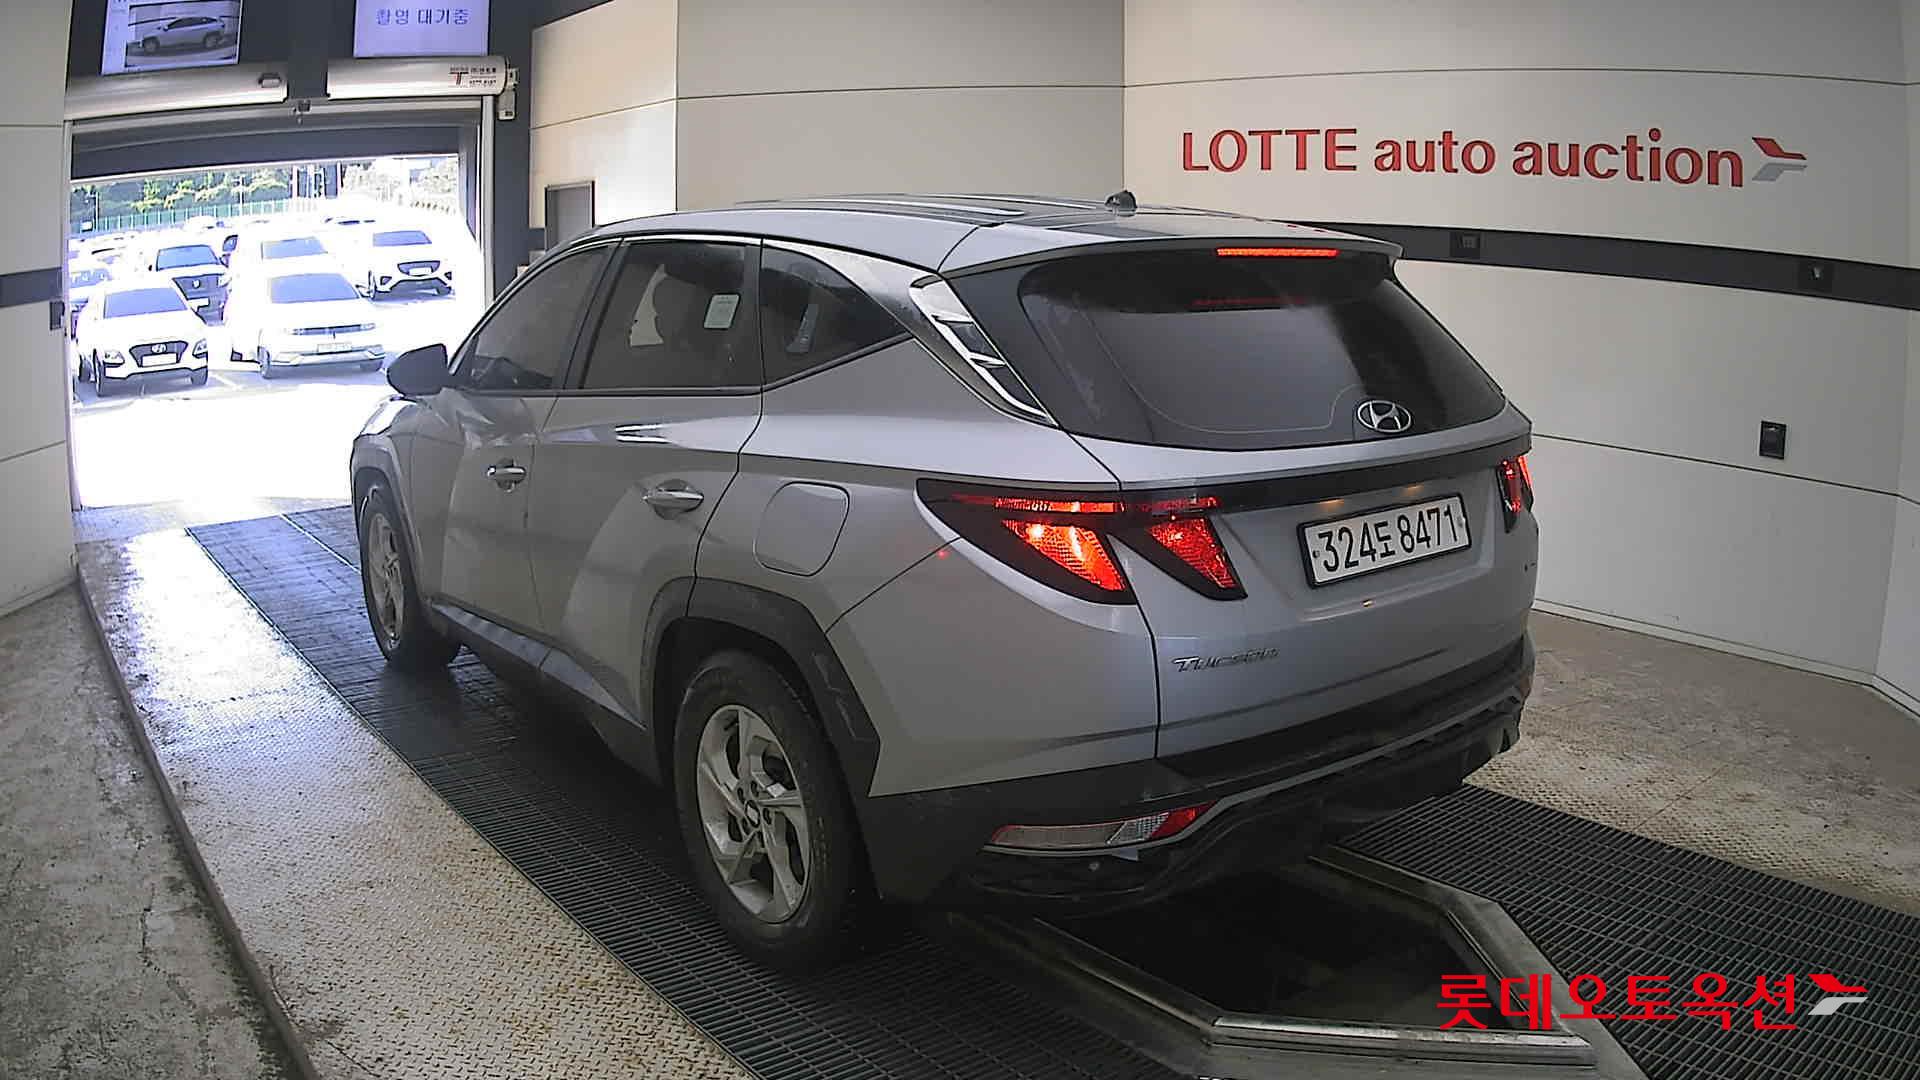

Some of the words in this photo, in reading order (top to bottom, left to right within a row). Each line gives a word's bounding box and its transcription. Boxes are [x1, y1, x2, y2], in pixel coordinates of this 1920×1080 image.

[417, 8, 470, 26] 대기중
[1182, 128, 1358, 172] LOTTE
[1373, 130, 1496, 174] auto
[1512, 127, 1744, 188] auction
